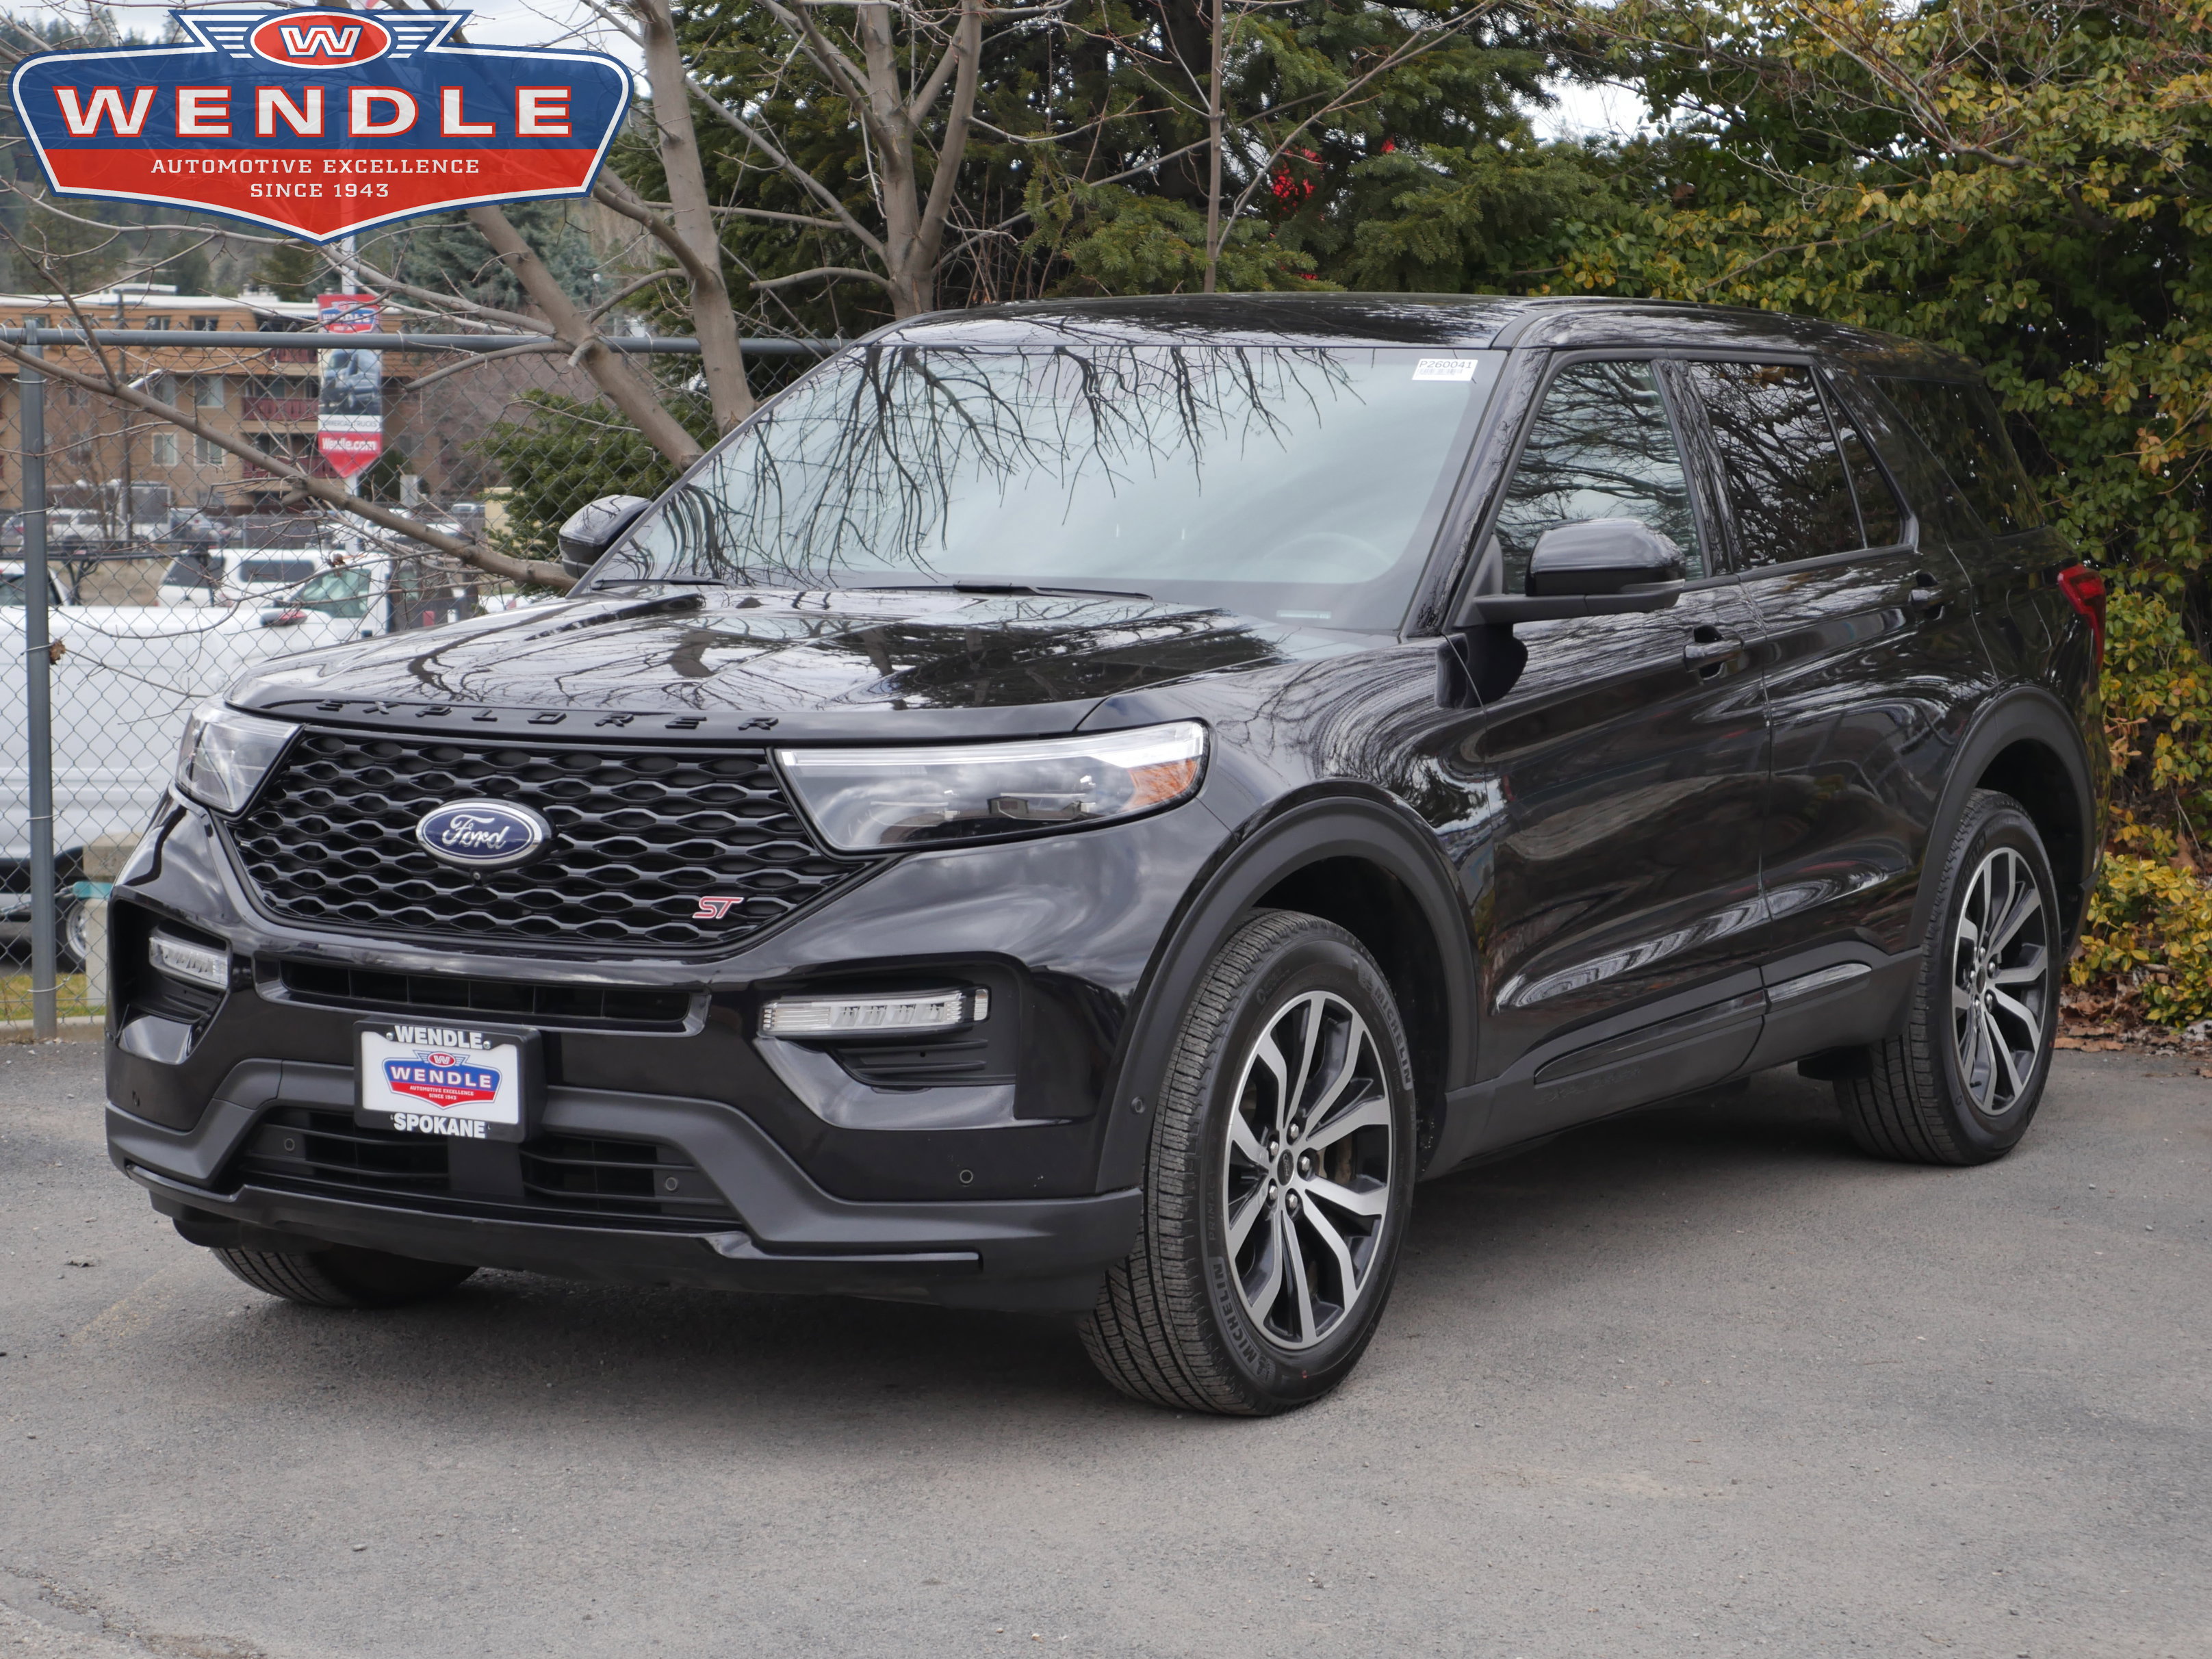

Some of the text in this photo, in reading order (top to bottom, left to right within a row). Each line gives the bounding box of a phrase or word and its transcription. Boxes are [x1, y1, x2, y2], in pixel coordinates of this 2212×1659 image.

[322, 313, 372, 323] WEDLE
[1419, 360, 1472, 369] P260041
[322, 437, 376, 451] Wendle.com
[316, 699, 780, 731] EXPLORER
[441, 814, 509, 850] Ford
[692, 895, 744, 918] ST
[394, 1025, 485, 1049] WENDLE
[1374, 988, 1411, 1084] MICHELIN
[390, 1066, 491, 1088] WENDLE
[394, 1112, 486, 1138] SPOKANE
[1213, 1263, 1257, 1363] MICHELIN
